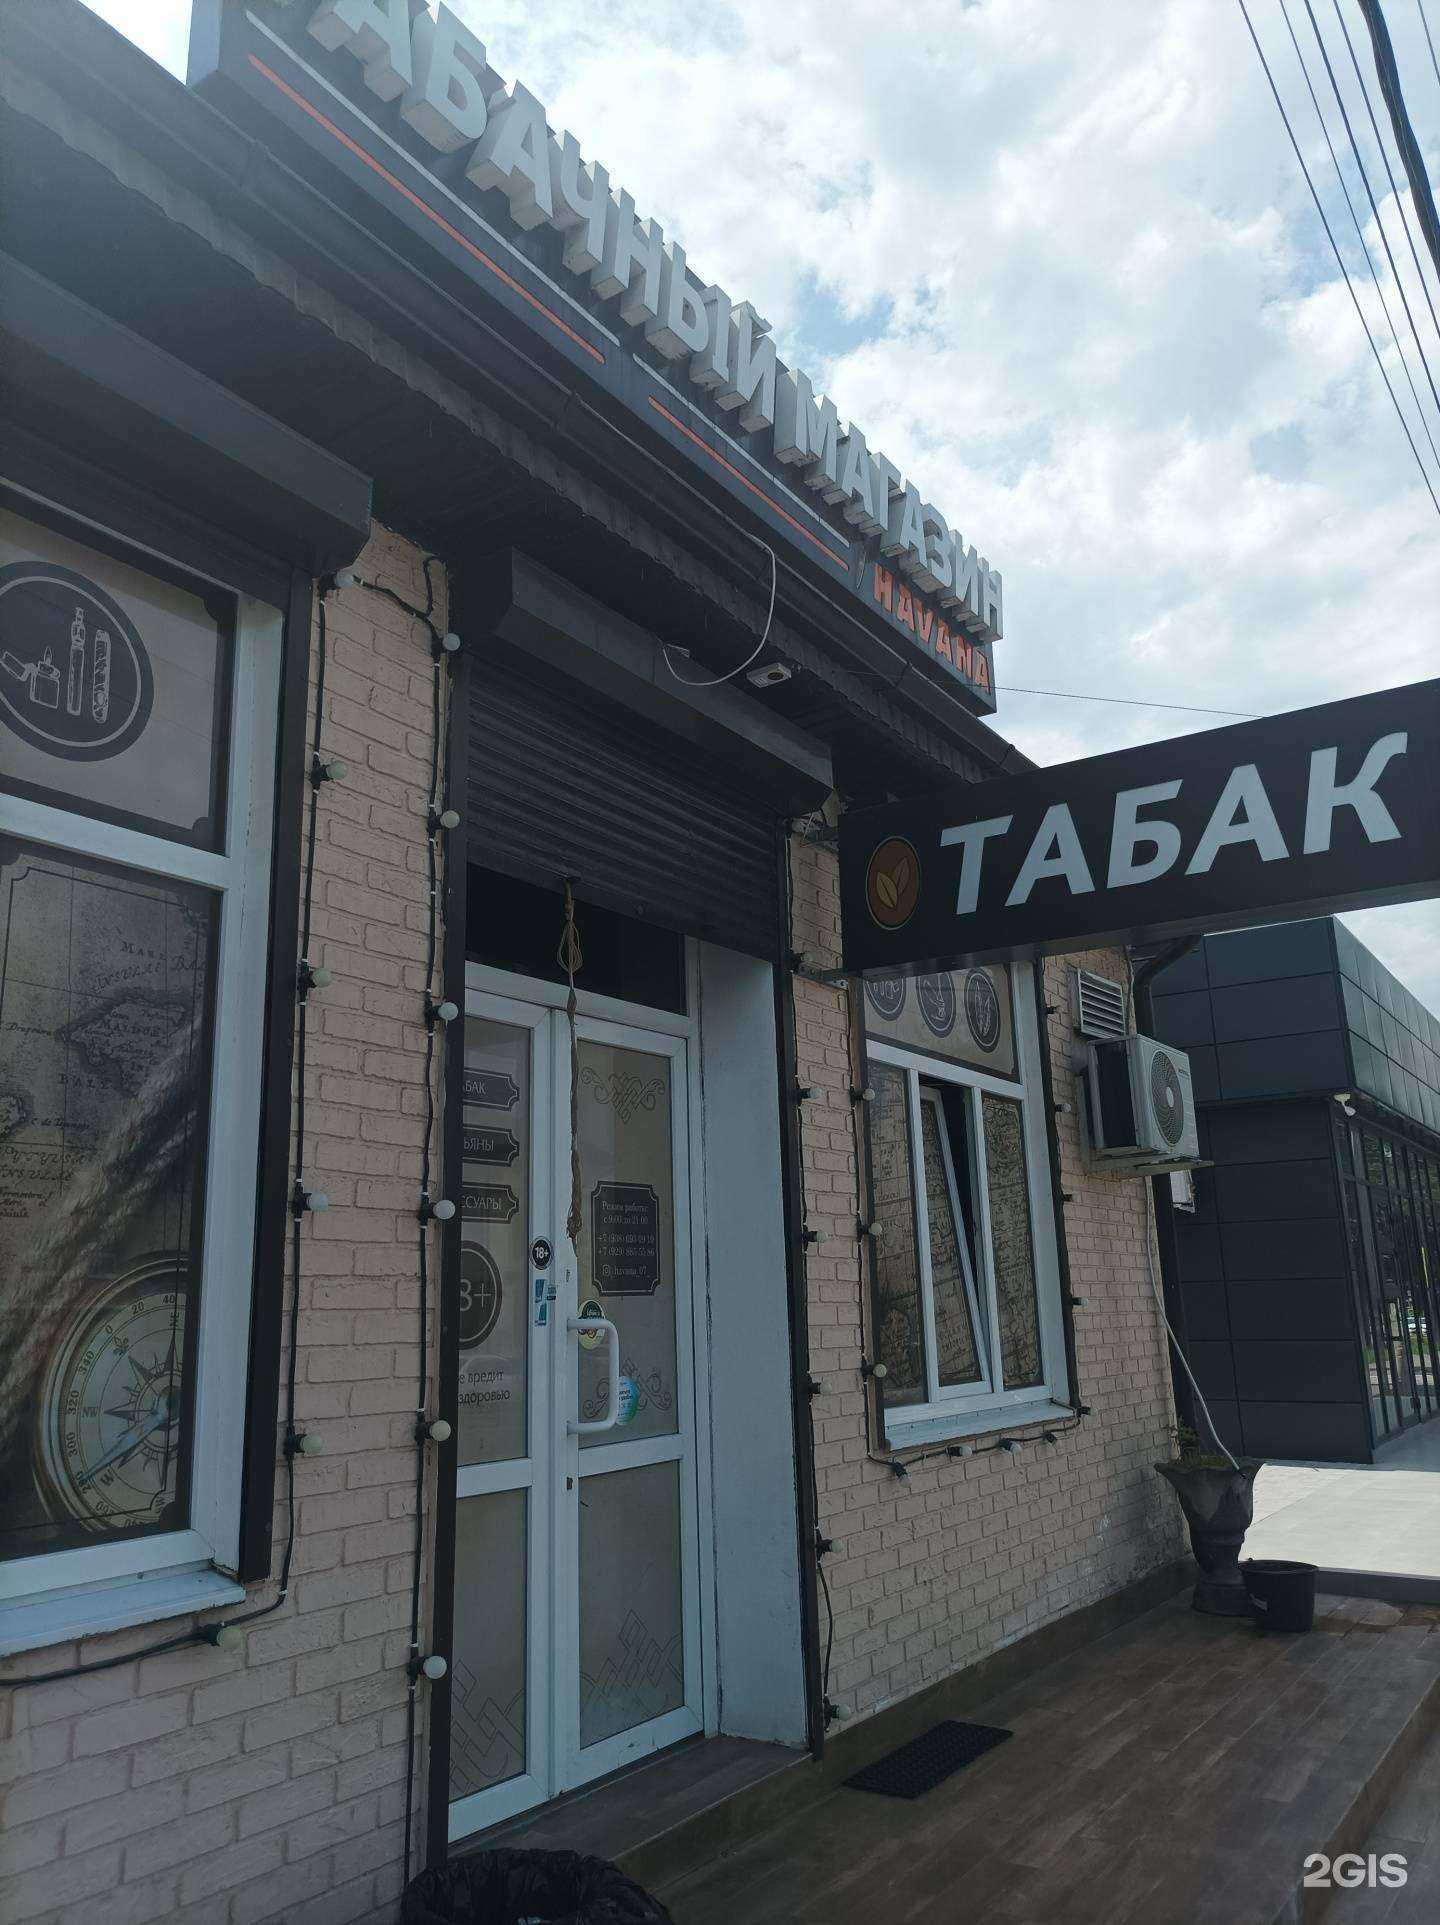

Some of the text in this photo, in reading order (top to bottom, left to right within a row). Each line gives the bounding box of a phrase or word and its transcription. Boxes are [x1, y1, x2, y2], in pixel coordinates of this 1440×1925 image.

[775, 368, 1002, 640] МАГАЗИН
[874, 562, 993, 696] HAVANA
[940, 731, 1408, 915] ТАБАК
[463, 1080, 486, 1095] БАК
[534, 1246, 549, 1259] 18+
[162, 1294, 175, 1304] 40
[131, 1301, 145, 1315] 20
[468, 1369, 504, 1386] вредит
[67, 1390, 80, 1416] 320
[458, 1388, 511, 1404] здоровью
[67, 1432, 79, 1458] 300
